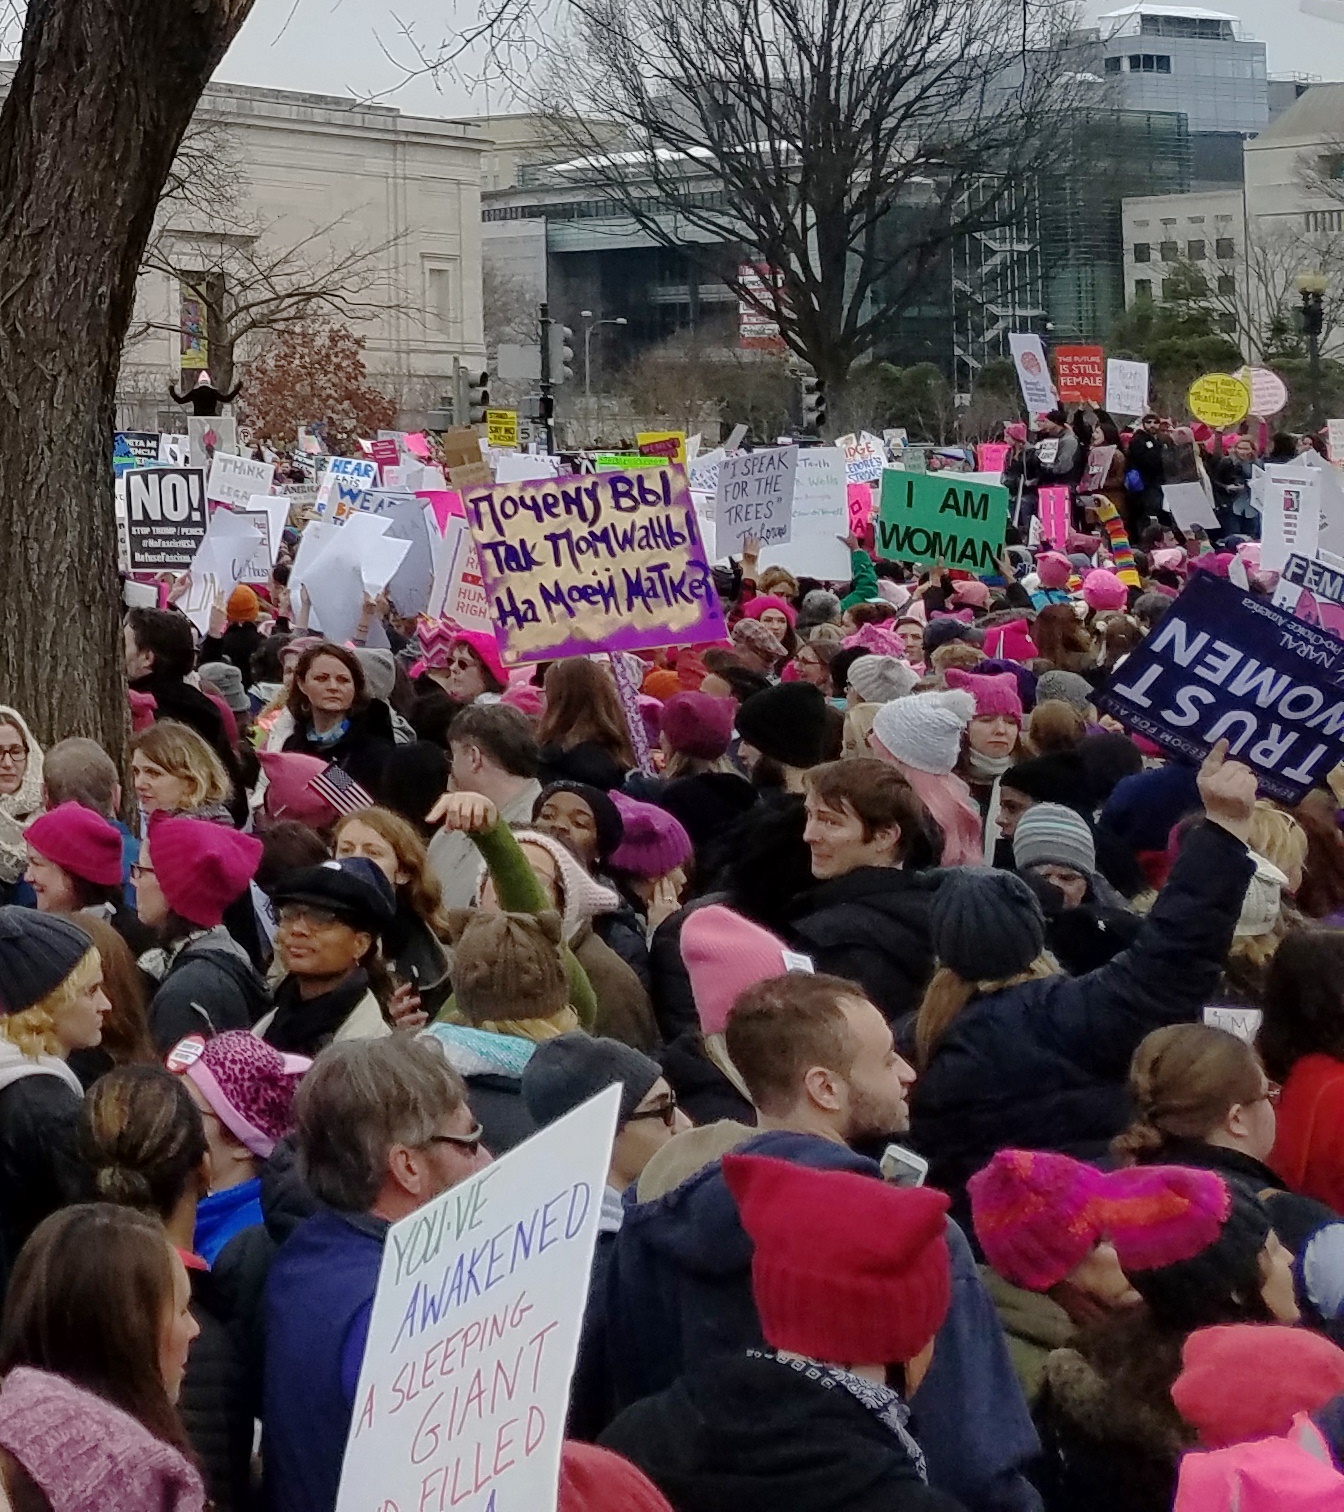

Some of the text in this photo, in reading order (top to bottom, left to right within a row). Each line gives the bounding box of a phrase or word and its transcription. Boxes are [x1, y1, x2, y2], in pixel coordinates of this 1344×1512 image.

[1059, 364, 1102, 374] IS STILL
[1060, 376, 1103, 387] FEMALE
[330, 458, 375, 478] HEAR
[740, 451, 789, 477] SPEAK
[129, 473, 202, 522] NO!
[219, 485, 250, 502] LEGA
[338, 482, 374, 511] WE
[724, 475, 783, 502] FOR THE
[906, 480, 990, 521] I AM
[151, 526, 177, 535] TRUMP
[879, 519, 1003, 573] WOMAN
[456, 601, 488, 618] RIGH
[1278, 631, 1336, 669] NARAL
[1112, 663, 1329, 785] TRUST
[1159, 731, 1207, 760] EEDOM
[389, 1181, 591, 1354] AWAKENED
[354, 1289, 534, 1439] A SLEEPING
[410, 1320, 560, 1466] GIANT
[419, 1404, 546, 1512] FILLED
